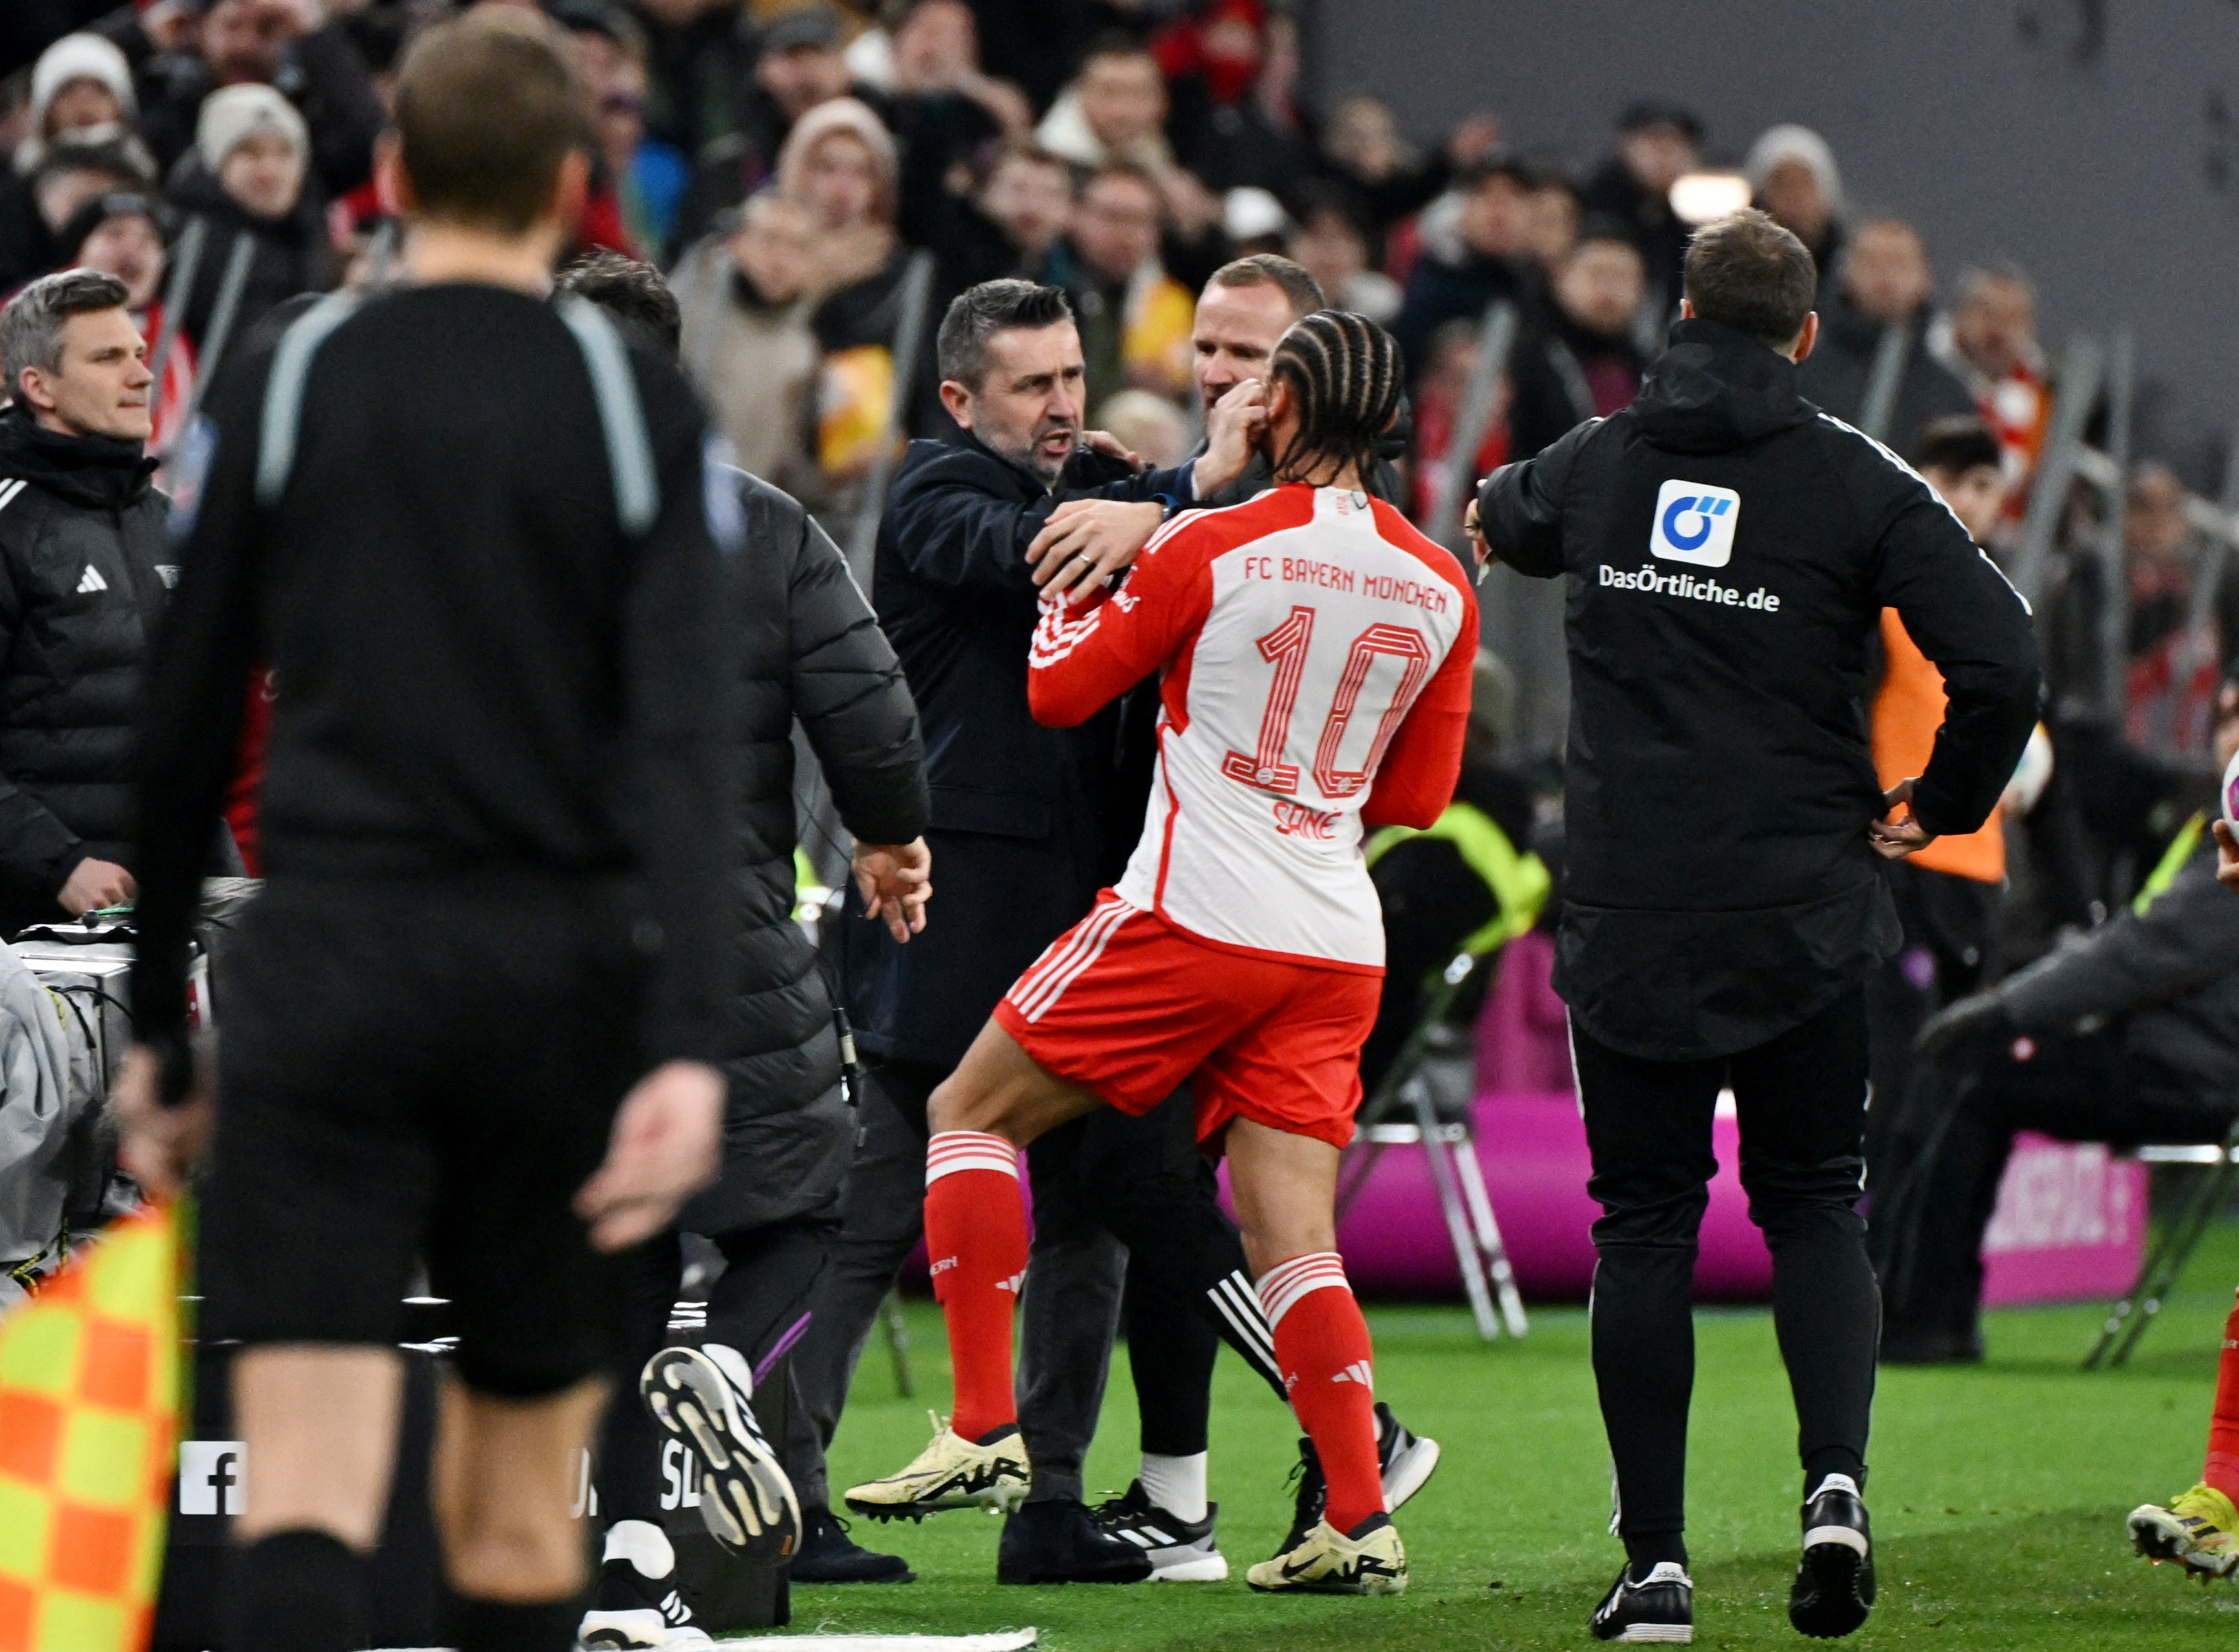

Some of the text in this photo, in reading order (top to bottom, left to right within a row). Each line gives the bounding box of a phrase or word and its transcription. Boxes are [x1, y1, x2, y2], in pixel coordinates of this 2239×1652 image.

[1245, 557, 1272, 580] FC
[1282, 558, 1355, 593] BAYERN
[1599, 564, 1781, 613] DasÖrtliche.de
[1221, 605, 1432, 799] 10
